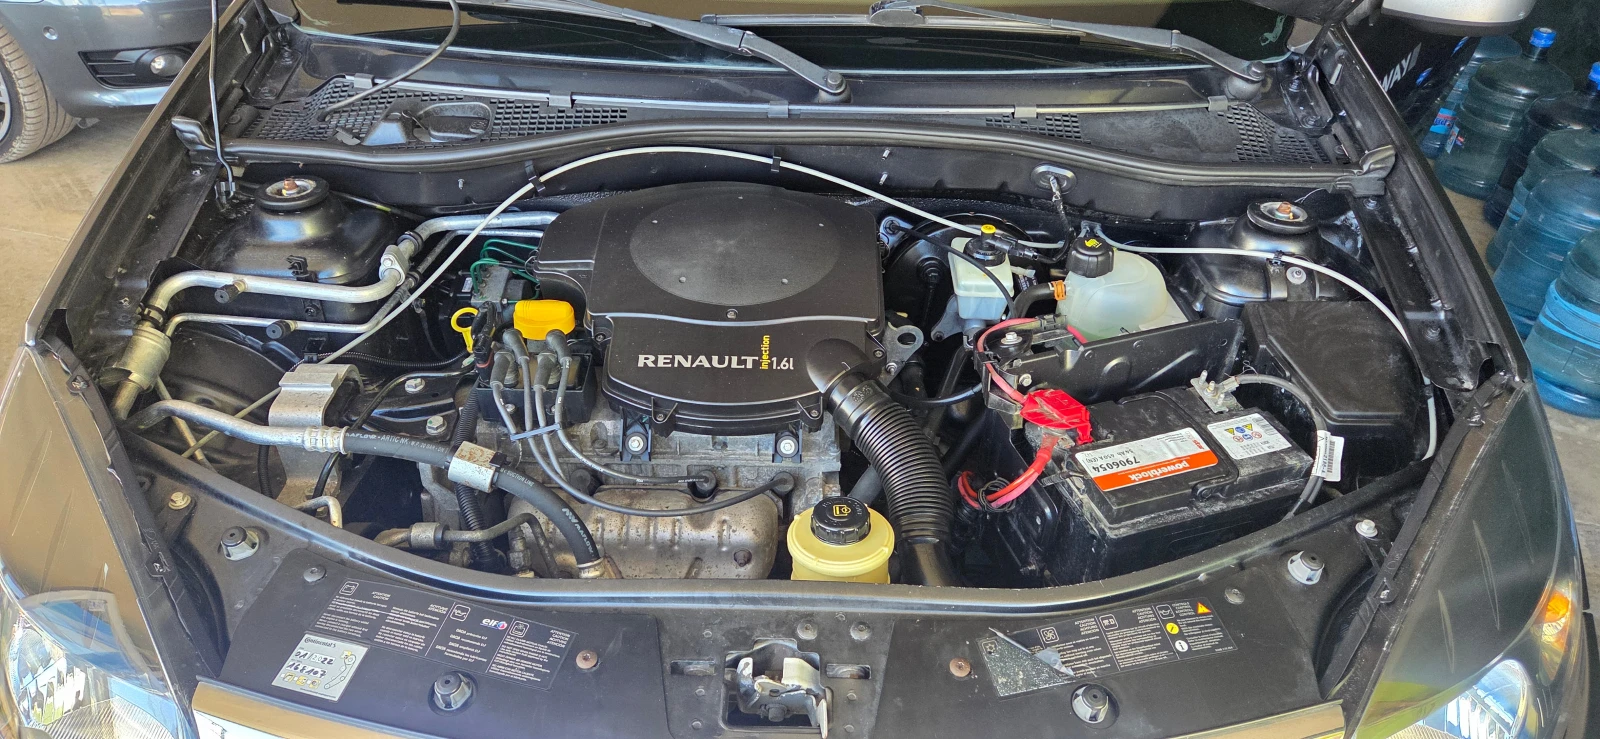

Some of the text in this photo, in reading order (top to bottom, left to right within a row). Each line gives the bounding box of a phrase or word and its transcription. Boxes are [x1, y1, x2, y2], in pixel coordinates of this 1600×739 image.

[637, 354, 759, 369] RENAULT
[759, 334, 770, 370] injection
[1091, 455, 1140, 474] 7906054
[1128, 460, 1190, 483] powerblock
[482, 618, 499, 627] elf
[304, 637, 333, 649] Continental
